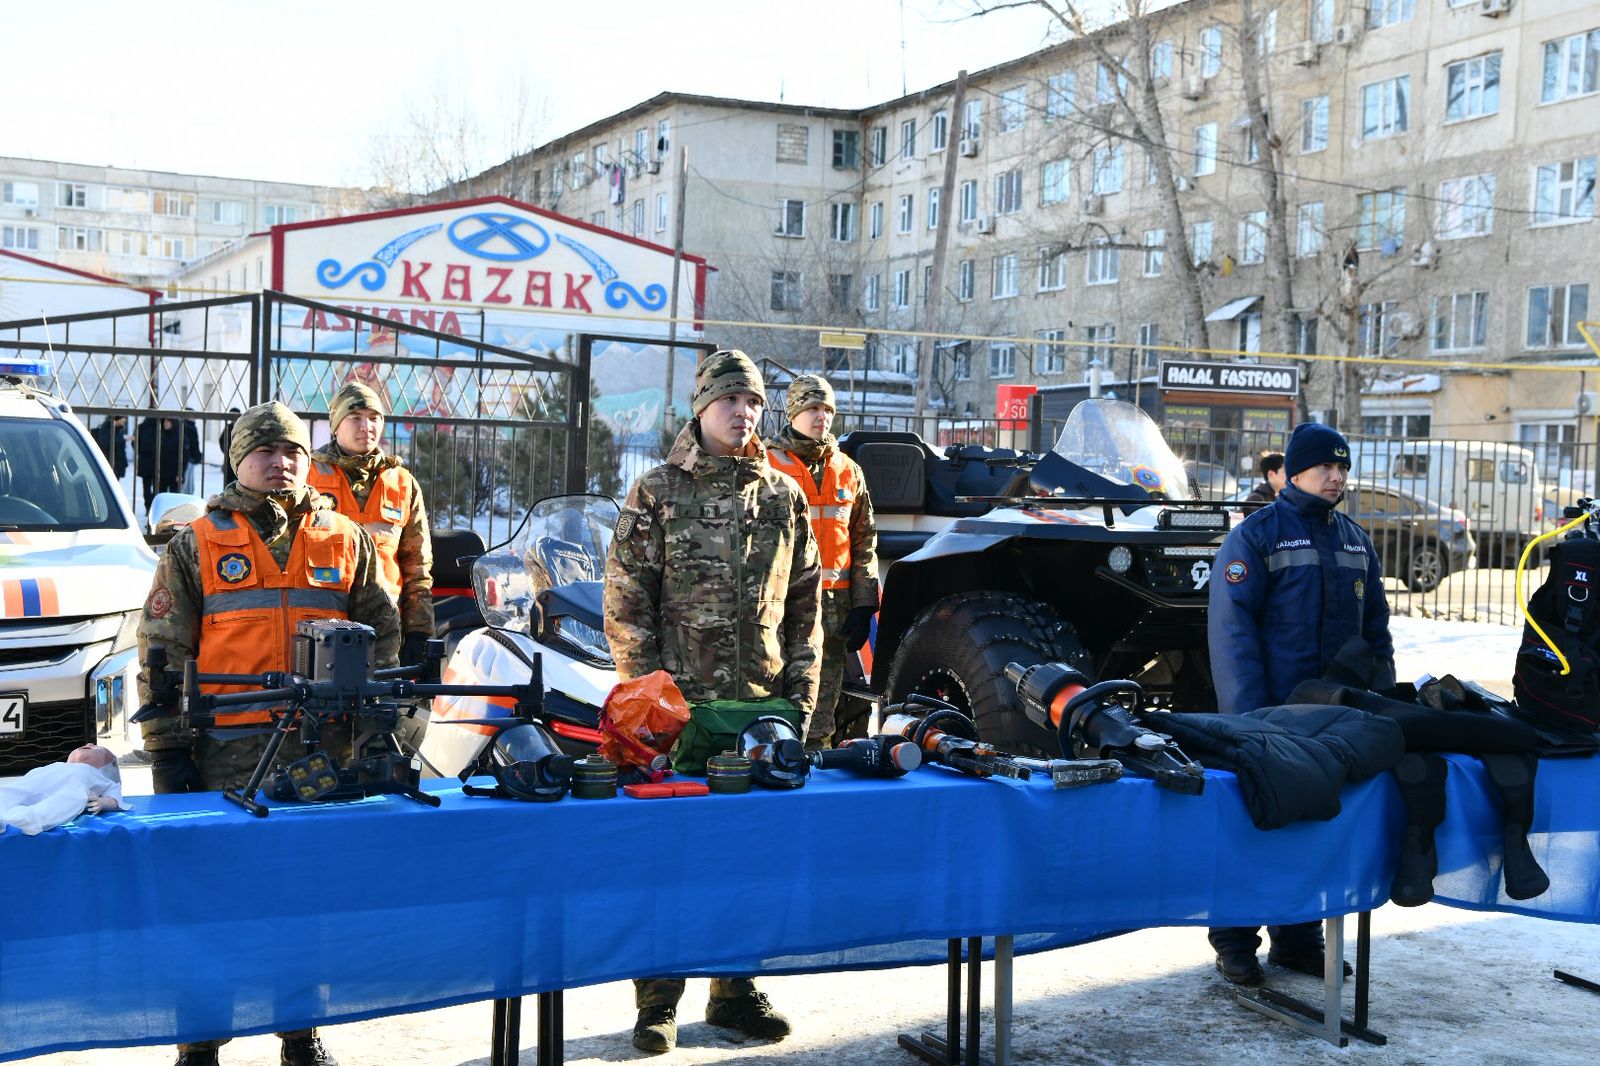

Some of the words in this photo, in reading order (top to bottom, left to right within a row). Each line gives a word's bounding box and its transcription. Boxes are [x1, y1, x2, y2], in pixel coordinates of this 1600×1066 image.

[400, 260, 592, 313] KAZAK
[303, 305, 462, 337] ASHANA
[1167, 367, 1214, 385] HALAL
[1220, 369, 1292, 389] FASTFOOD
[1575, 570, 1587, 581] XL
[3, 702, 20, 729] 4
